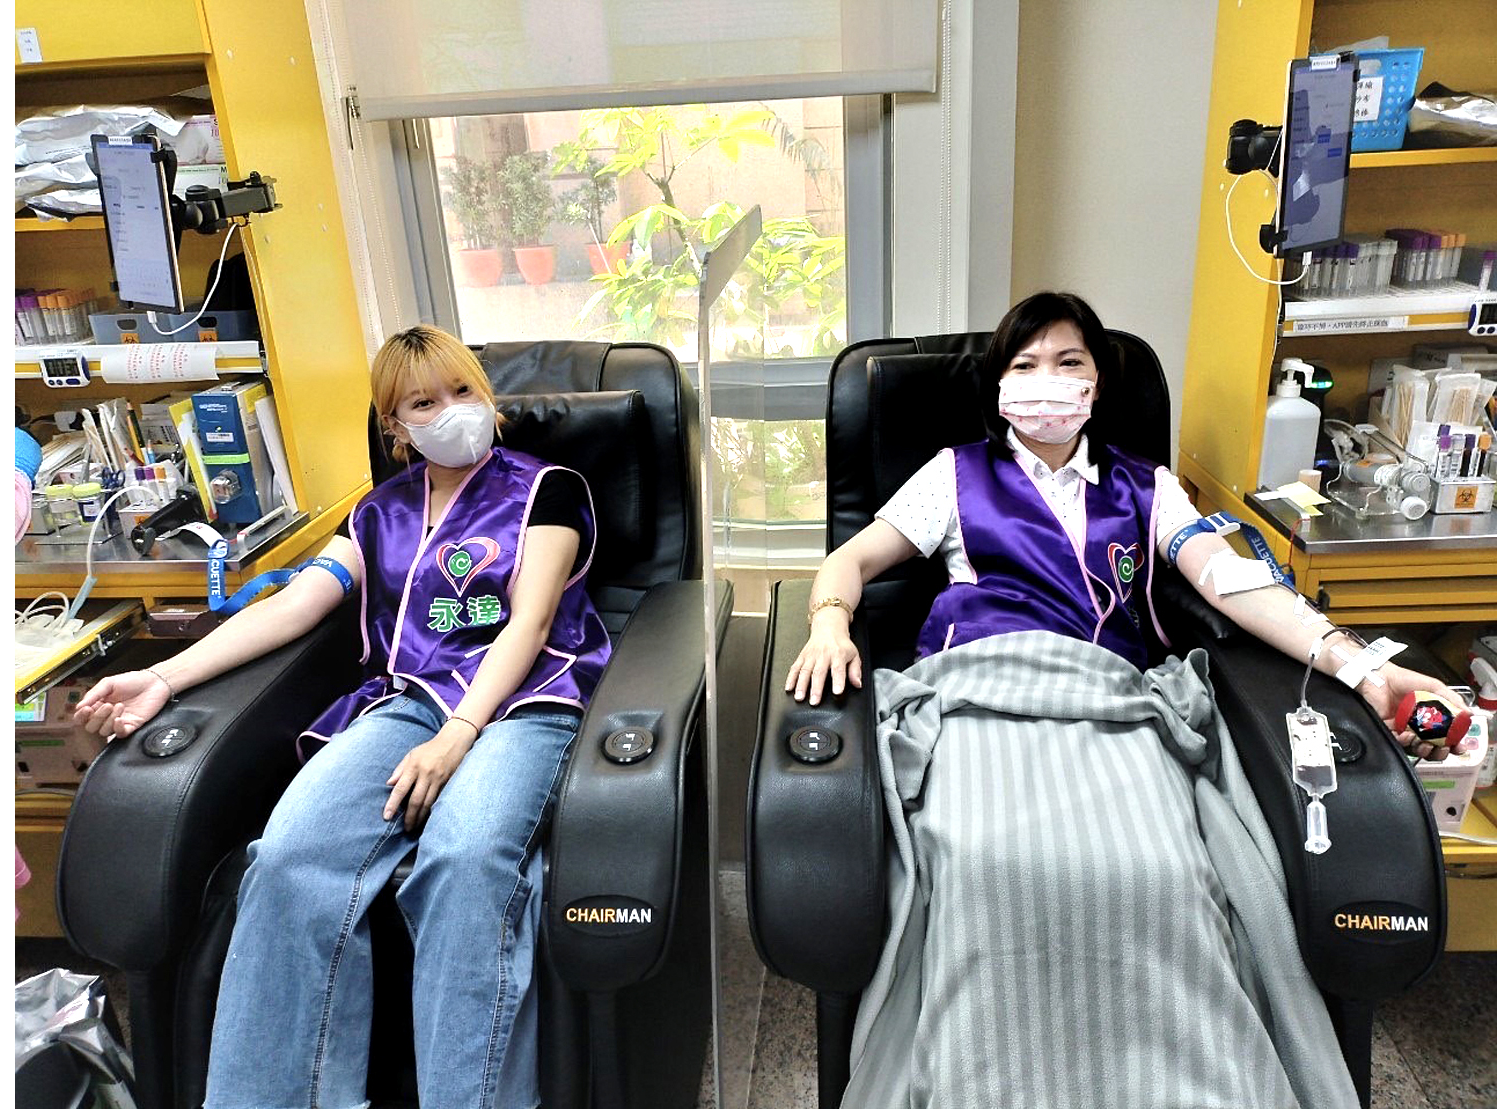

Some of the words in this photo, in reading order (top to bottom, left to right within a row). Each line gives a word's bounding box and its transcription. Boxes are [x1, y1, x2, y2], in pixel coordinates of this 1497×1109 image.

[426, 595, 502, 633] 永達
[566, 907, 652, 923] CHAIRMAN
[1334, 913, 1429, 932] CHAIRMAN
